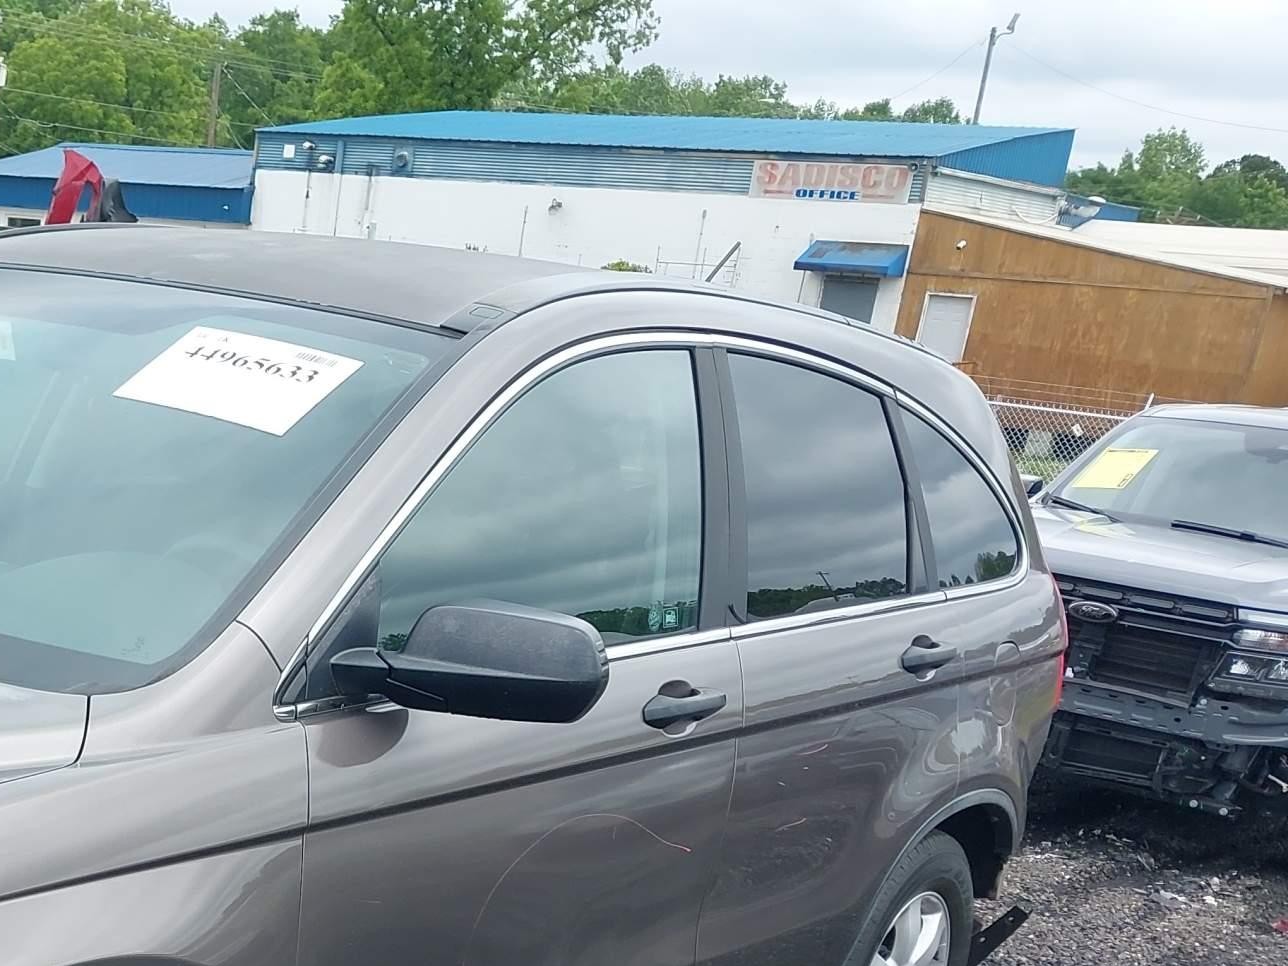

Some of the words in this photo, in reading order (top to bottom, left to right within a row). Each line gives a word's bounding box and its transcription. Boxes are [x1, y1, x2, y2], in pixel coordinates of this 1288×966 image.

[756, 162, 909, 192] SADISCO
[795, 188, 861, 201] OFFICE
[185, 345, 320, 384] 44965633
